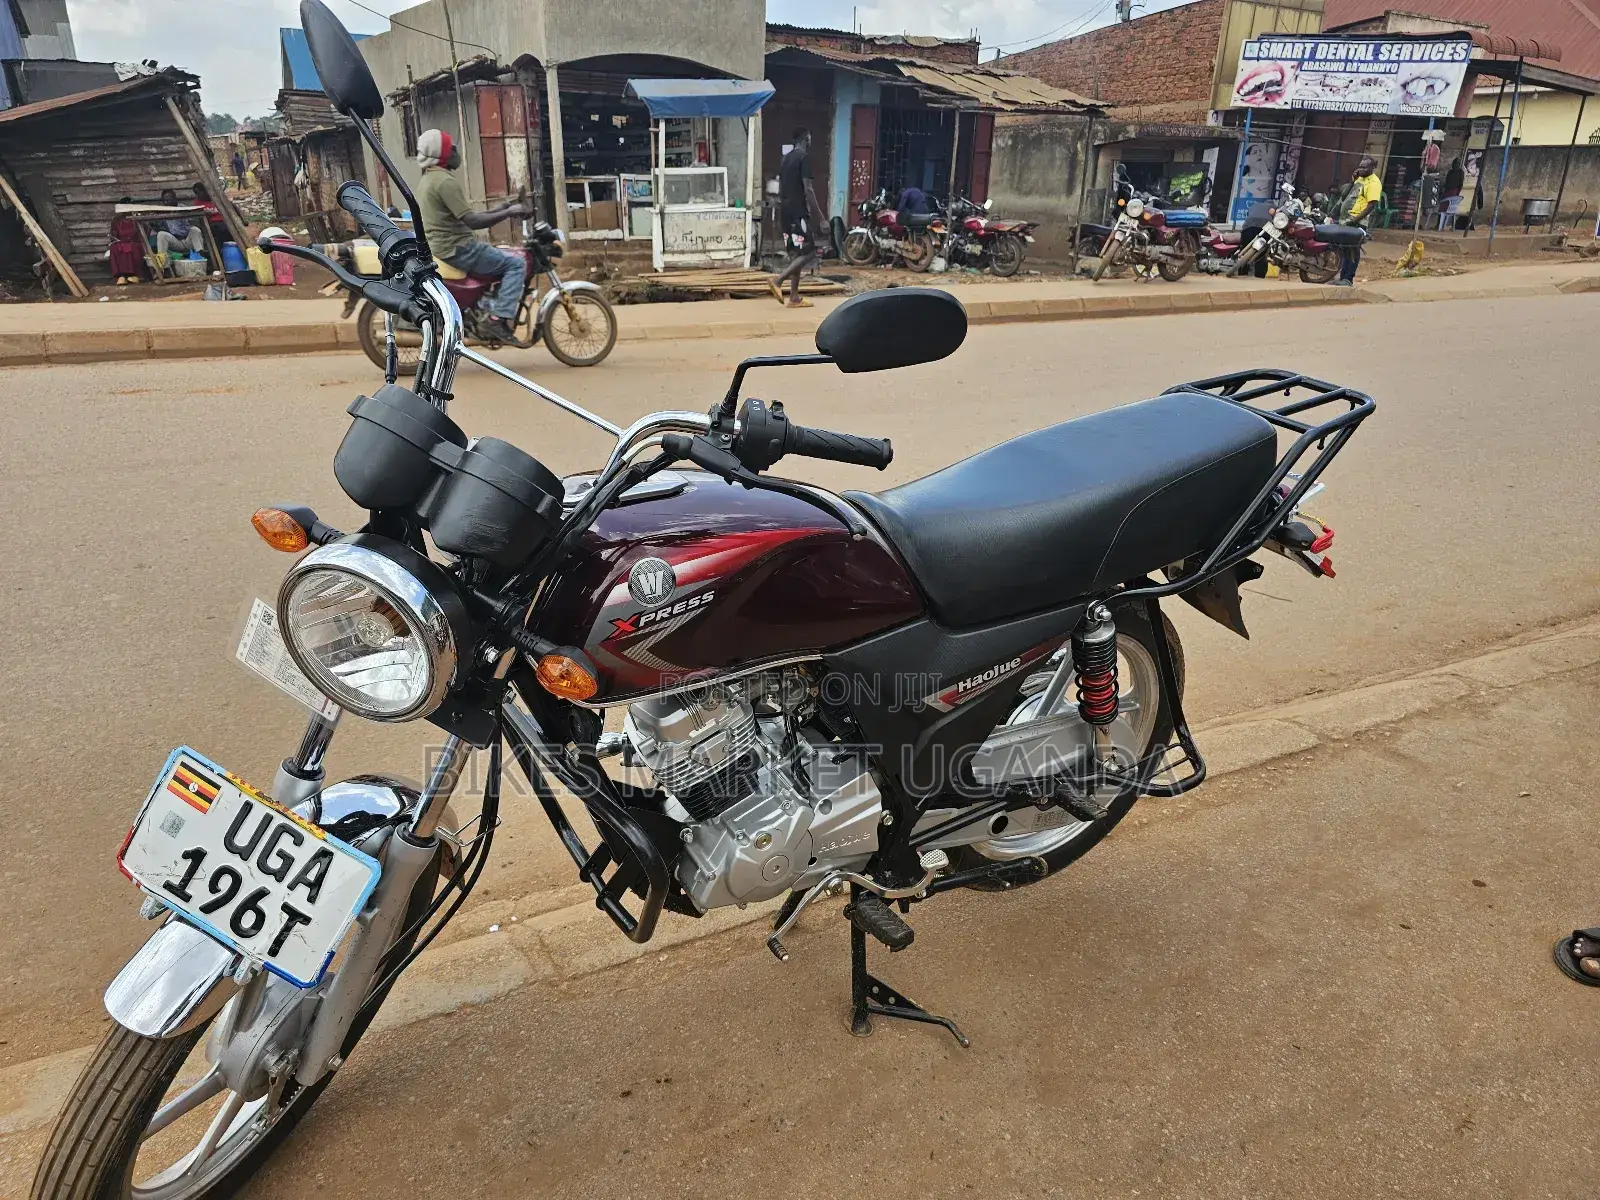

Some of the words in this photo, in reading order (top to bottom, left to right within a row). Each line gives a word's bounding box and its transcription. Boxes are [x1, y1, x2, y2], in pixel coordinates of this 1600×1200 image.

[1259, 41, 1315, 59] SMART
[1315, 42, 1375, 60] DENTAL
[1378, 42, 1469, 61] SERVICES
[1301, 60, 1345, 72] ABASAWO
[1292, 99, 1303, 109] TEL
[1399, 103, 1421, 114] Wona
[601, 590, 715, 642] XPRESS
[223, 799, 335, 905] UGA
[162, 846, 313, 958] 196T
